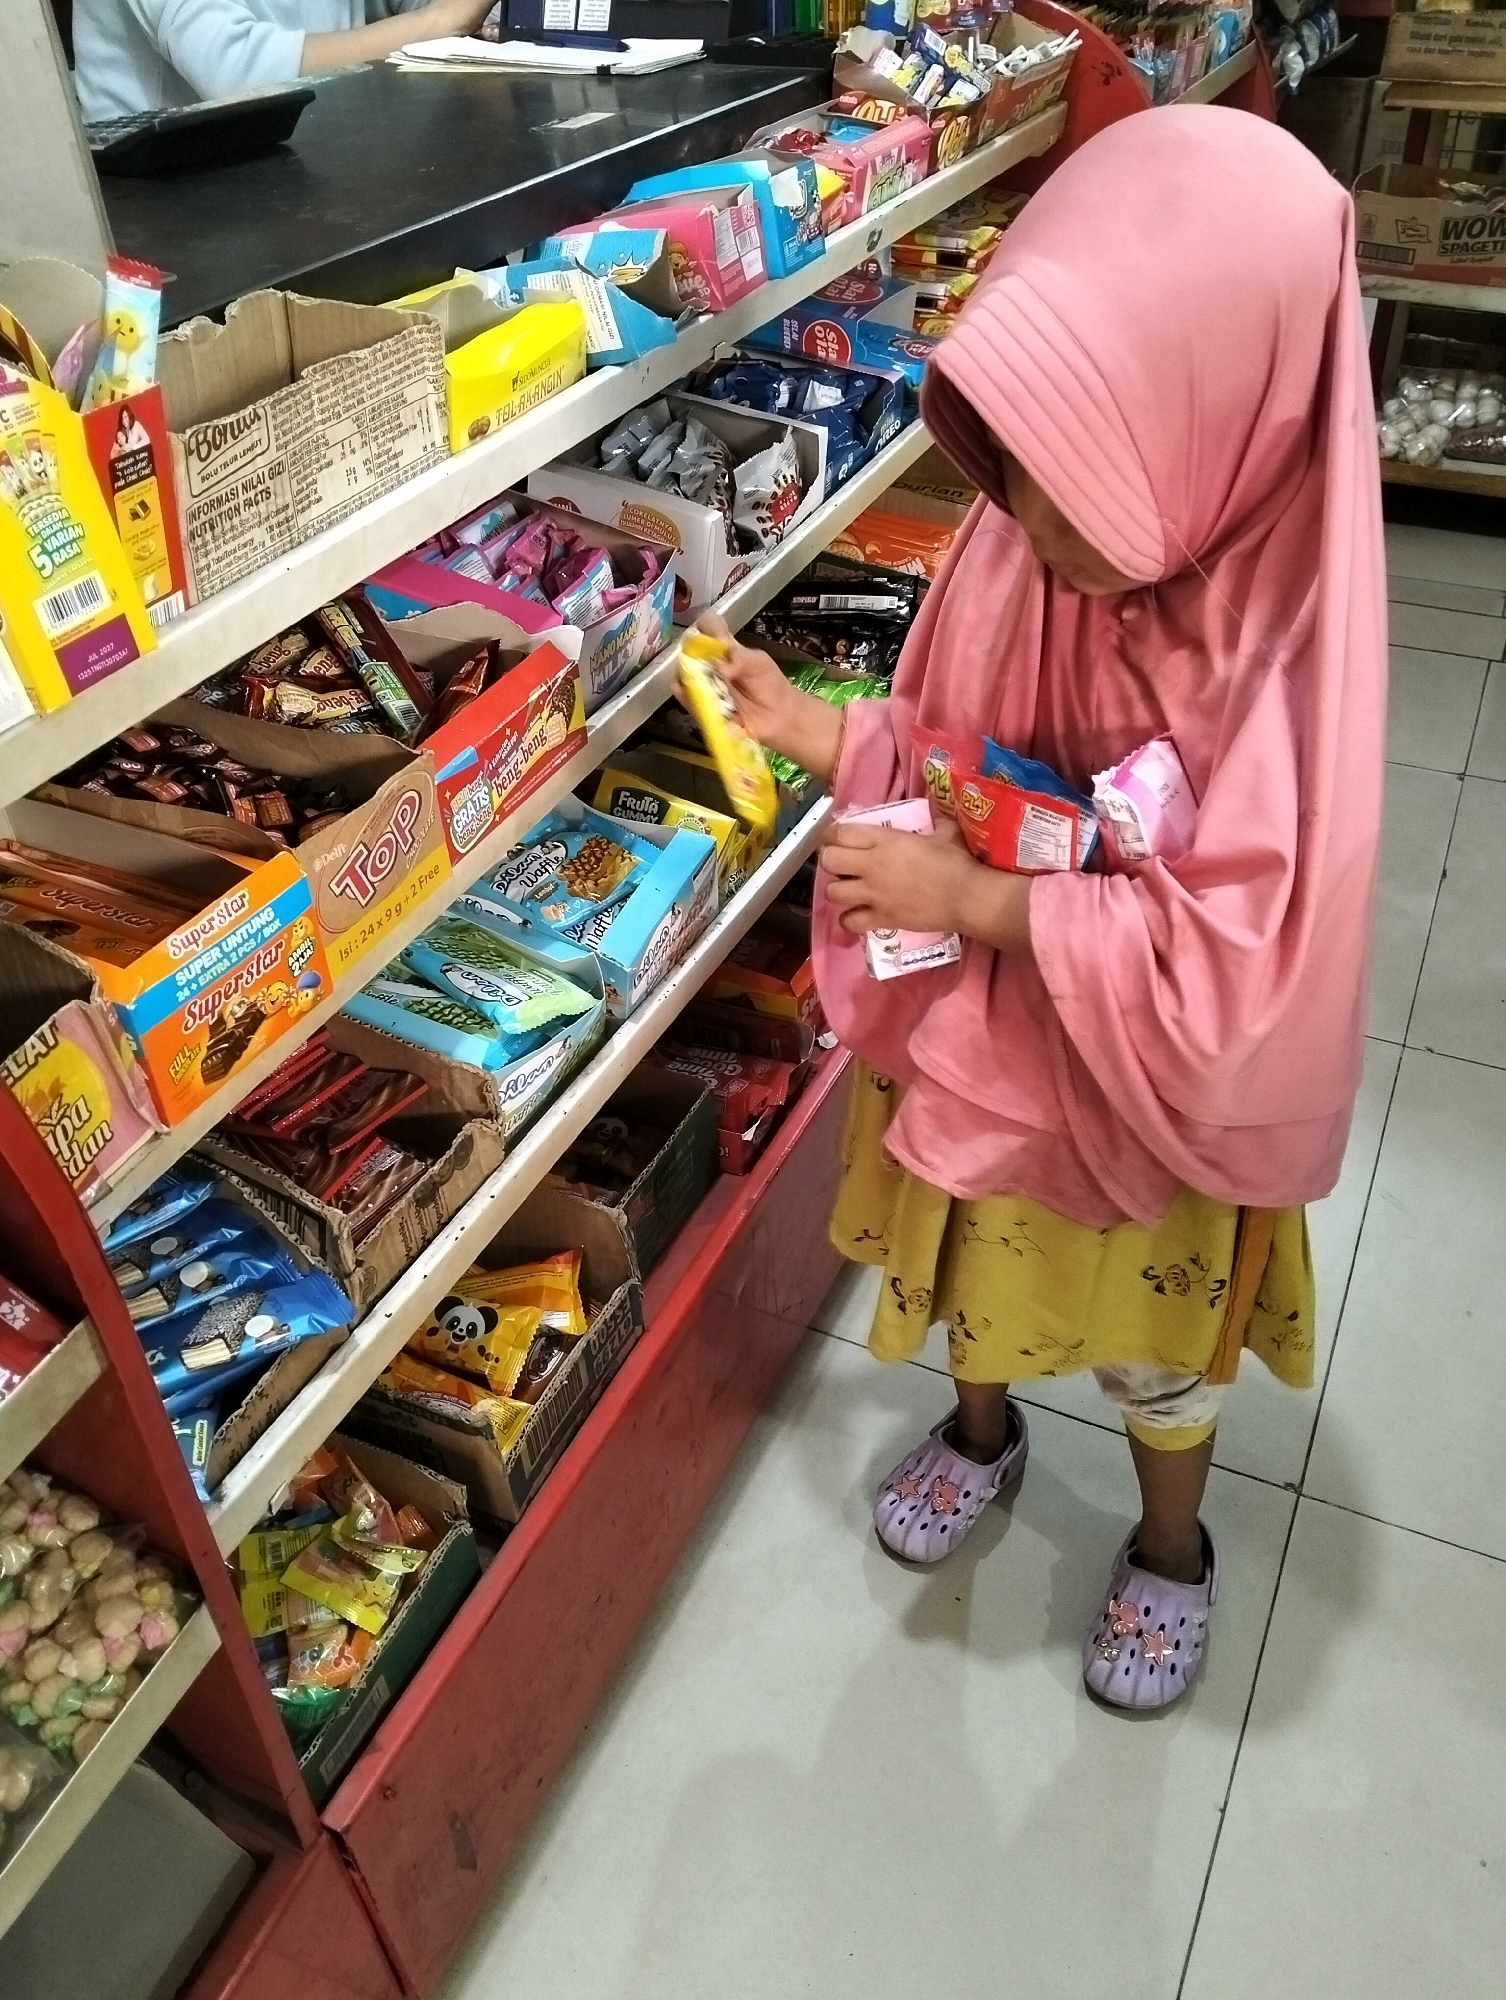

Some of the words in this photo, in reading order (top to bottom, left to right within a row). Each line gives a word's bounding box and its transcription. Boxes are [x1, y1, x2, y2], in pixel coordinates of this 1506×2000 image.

[200, 467, 219, 484] BOLU
[219, 453, 239, 473] TELUR
[238, 438, 263, 460] LEMBUT
[188, 485, 240, 526] INFORMASI
[240, 470, 266, 496] NILAI
[267, 458, 288, 482] GIZI
[890, 481, 964, 498] Durian
[27, 507, 70, 537] TERSEDIA
[188, 503, 242, 544] NUTRITION
[242, 486, 272, 513] FACTS
[623, 513, 645, 525] LUMER
[629, 507, 674, 532] COKELATNYA
[29, 544, 54, 579] 5
[43, 523, 85, 553] VARIAN
[50, 541, 83, 568] RASA
[87, 652, 99, 663] JUL
[100, 642, 115, 656] 2027
[491, 723, 548, 799] beng-beng
[925, 760, 955, 801] PLA
[452, 785, 490, 833] GRATIS
[457, 804, 492, 845] beng-beng
[612, 807, 659, 825] GUMMY
[960, 791, 995, 817] PLAY
[330, 789, 422, 909] TOP
[520, 854, 565, 890] Waffle
[170, 889, 249, 959] Superstar
[338, 941, 352, 963] Isi
[359, 923, 375, 946] 24
[375, 918, 384, 929] x
[384, 907, 393, 923] 9
[393, 901, 403, 917] g
[410, 883, 419, 899] 2
[419, 862, 441, 891] Free
[175, 946, 223, 987] SUPER
[221, 906, 276, 951] UNTUNG
[177, 987, 191, 1002] 24
[198, 960, 231, 987] EXTRA
[230, 952, 239, 964] 2
[238, 940, 257, 958] PCS
[263, 918, 282, 937] BOX
[288, 936, 313, 967] AMBIL
[182, 938, 288, 1035] Superstar
[168, 1044, 191, 1080] FULL
[700, 1060, 744, 1076] Goo
